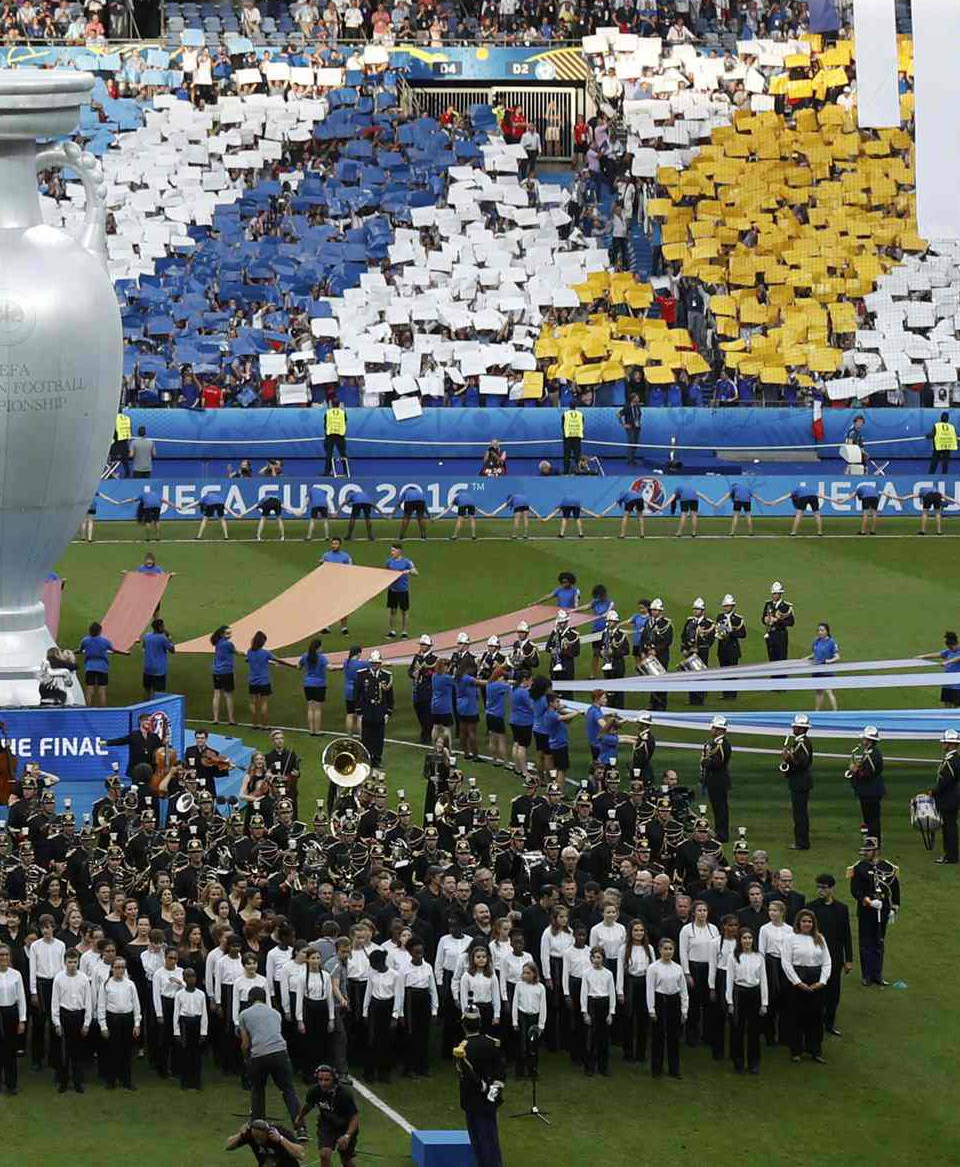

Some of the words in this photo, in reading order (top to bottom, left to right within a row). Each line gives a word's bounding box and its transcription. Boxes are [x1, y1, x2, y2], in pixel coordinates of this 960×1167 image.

[512, 63, 529, 75] D2
[12, 376, 88, 395] FOOTBALL
[40, 737, 109, 757] FINAL
